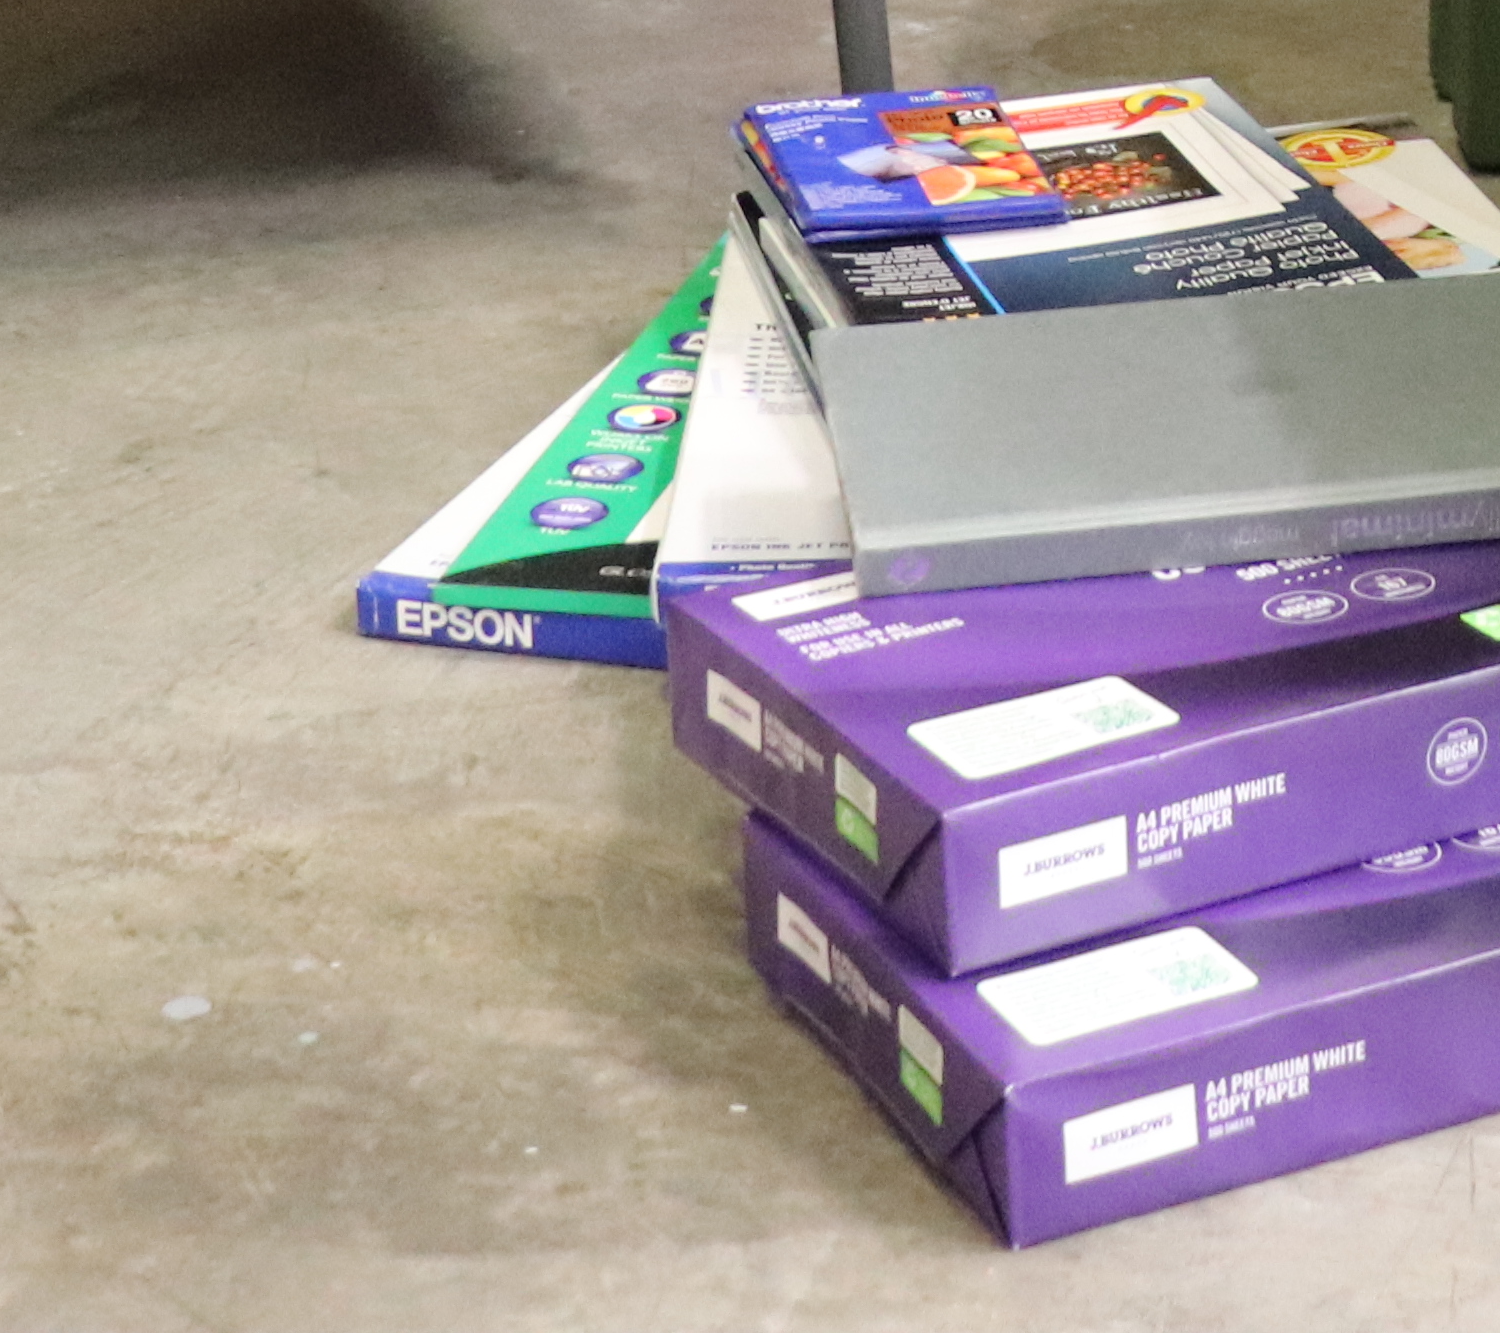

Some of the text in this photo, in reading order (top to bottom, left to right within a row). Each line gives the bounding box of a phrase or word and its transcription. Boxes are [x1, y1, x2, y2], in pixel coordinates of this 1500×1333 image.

[755, 96, 863, 116] brother
[954, 107, 994, 122] 20
[1145, 241, 1225, 261] Photo
[1176, 249, 1360, 290] Photo Quality
[1191, 256, 1272, 277] Paper
[396, 599, 534, 650] EPSON
[889, 617, 965, 642] PRINTERS
[1136, 771, 1287, 834] A4 PREMIUM WHITE
[1137, 807, 1233, 854] COPY PAPER
[1023, 842, 1105, 877] J.BURROWS
[1205, 1039, 1367, 1104] A4 PREMIUM WHITE
[1206, 1075, 1311, 1123] COPY PAPER
[1090, 1112, 1173, 1151] J.BURROWS
